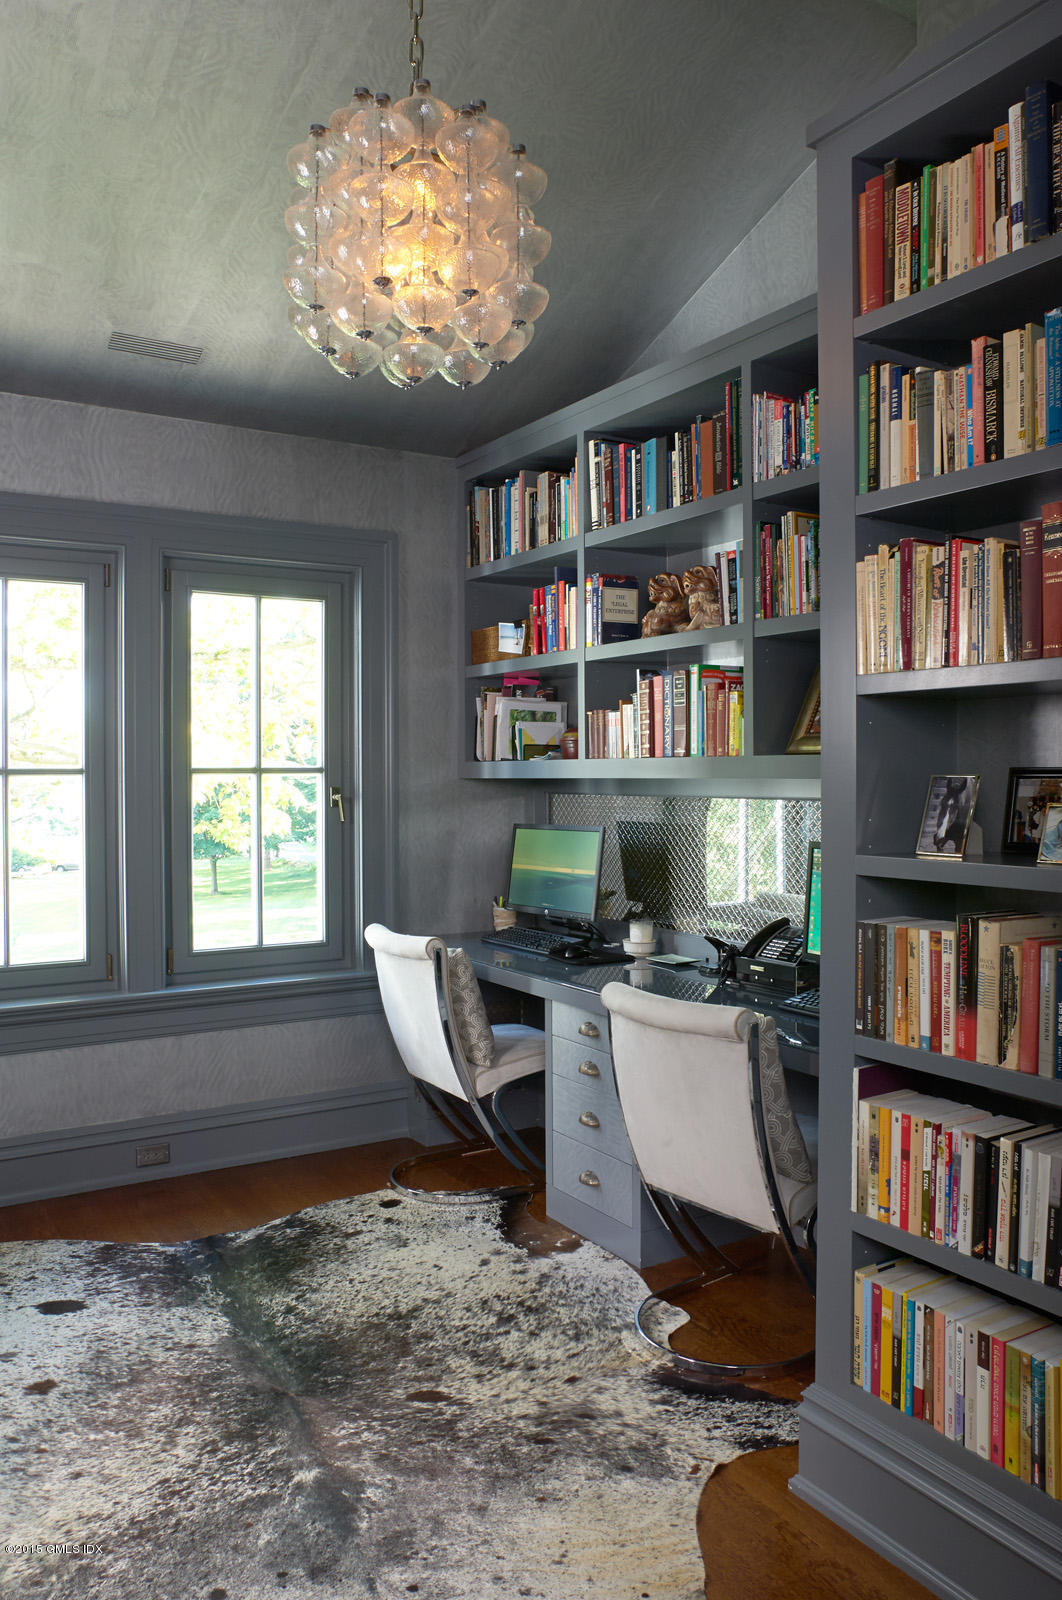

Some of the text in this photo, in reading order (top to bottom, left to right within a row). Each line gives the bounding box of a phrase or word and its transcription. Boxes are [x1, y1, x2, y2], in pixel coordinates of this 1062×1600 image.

[1013, 114, 1022, 142] Against
[1013, 157, 1022, 193] Enemies
[897, 186, 909, 246] MIDDLETOWN
[985, 347, 993, 387] CRANKSHAW
[992, 353, 1000, 380] EDWARD
[985, 389, 997, 444] BISMARCK
[959, 924, 968, 977] BLOODLINE
